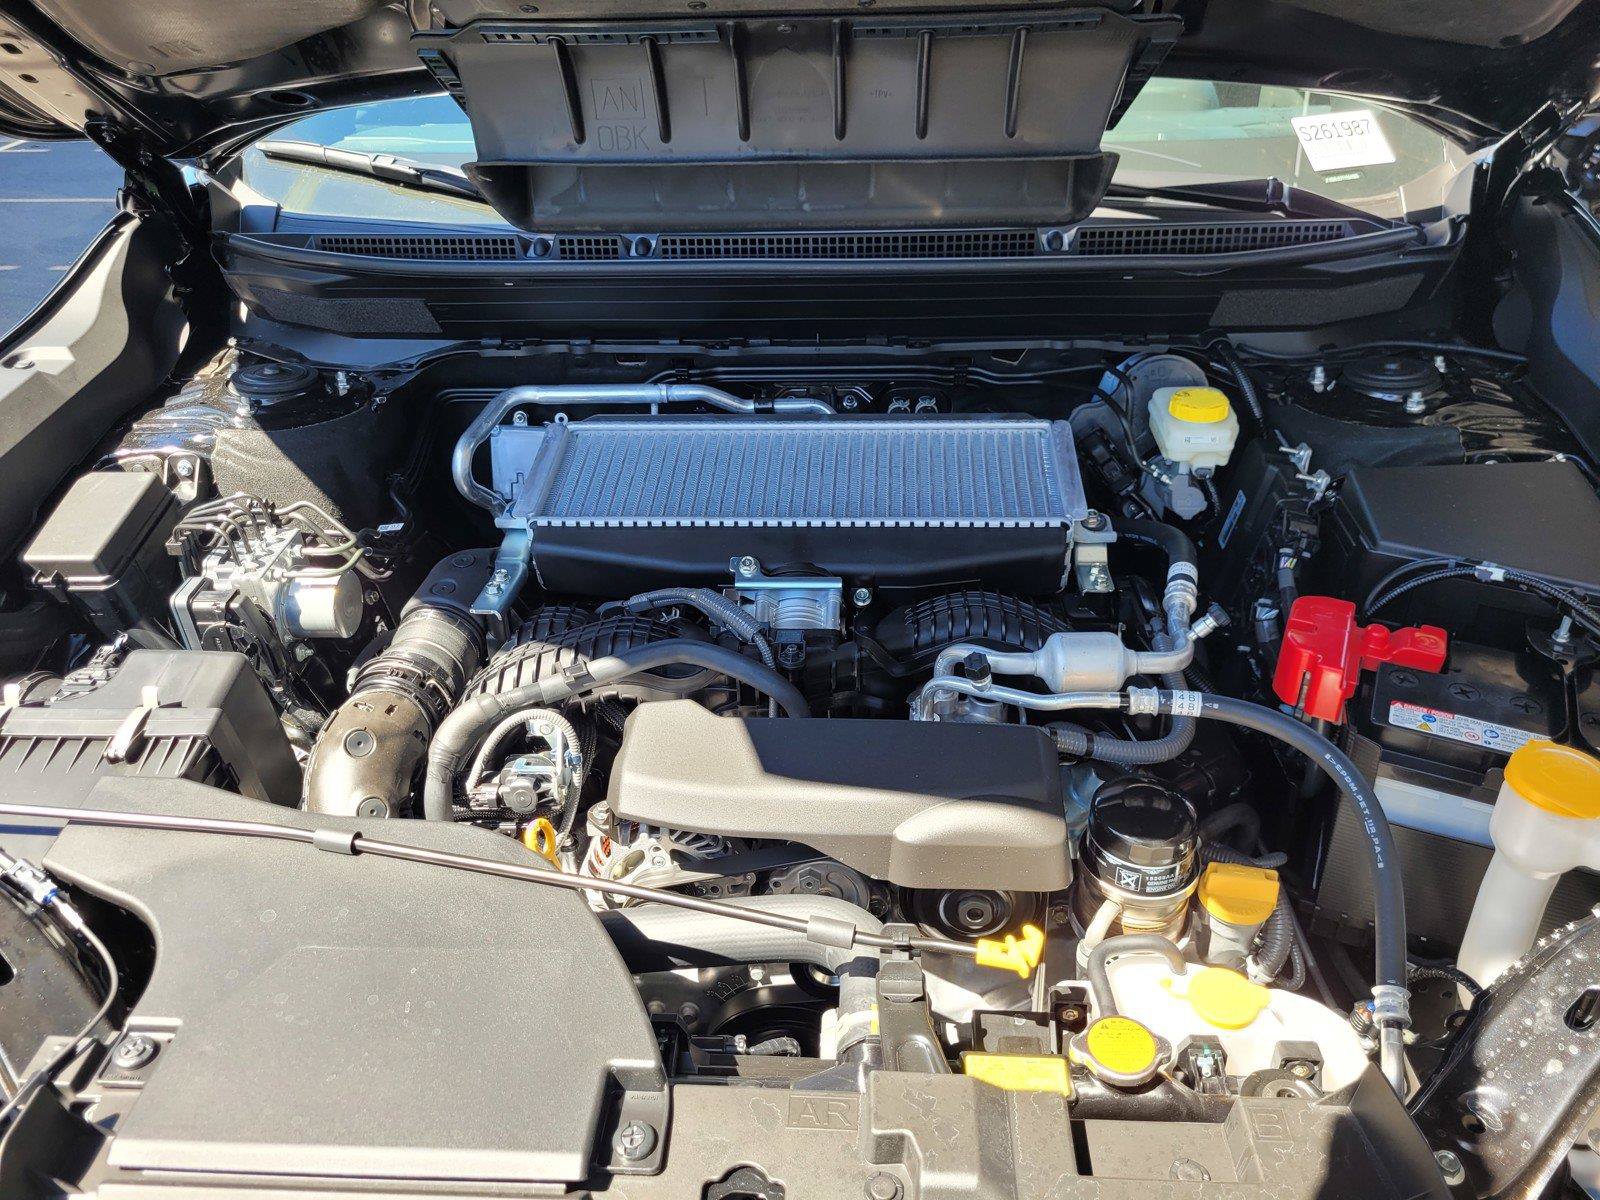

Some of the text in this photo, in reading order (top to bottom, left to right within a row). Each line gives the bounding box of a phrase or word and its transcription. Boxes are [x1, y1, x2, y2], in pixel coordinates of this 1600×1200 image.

[602, 86, 638, 112] AN
[597, 125, 650, 152] OBK
[1299, 119, 1370, 142] S261987
[792, 1099, 853, 1126] AR
